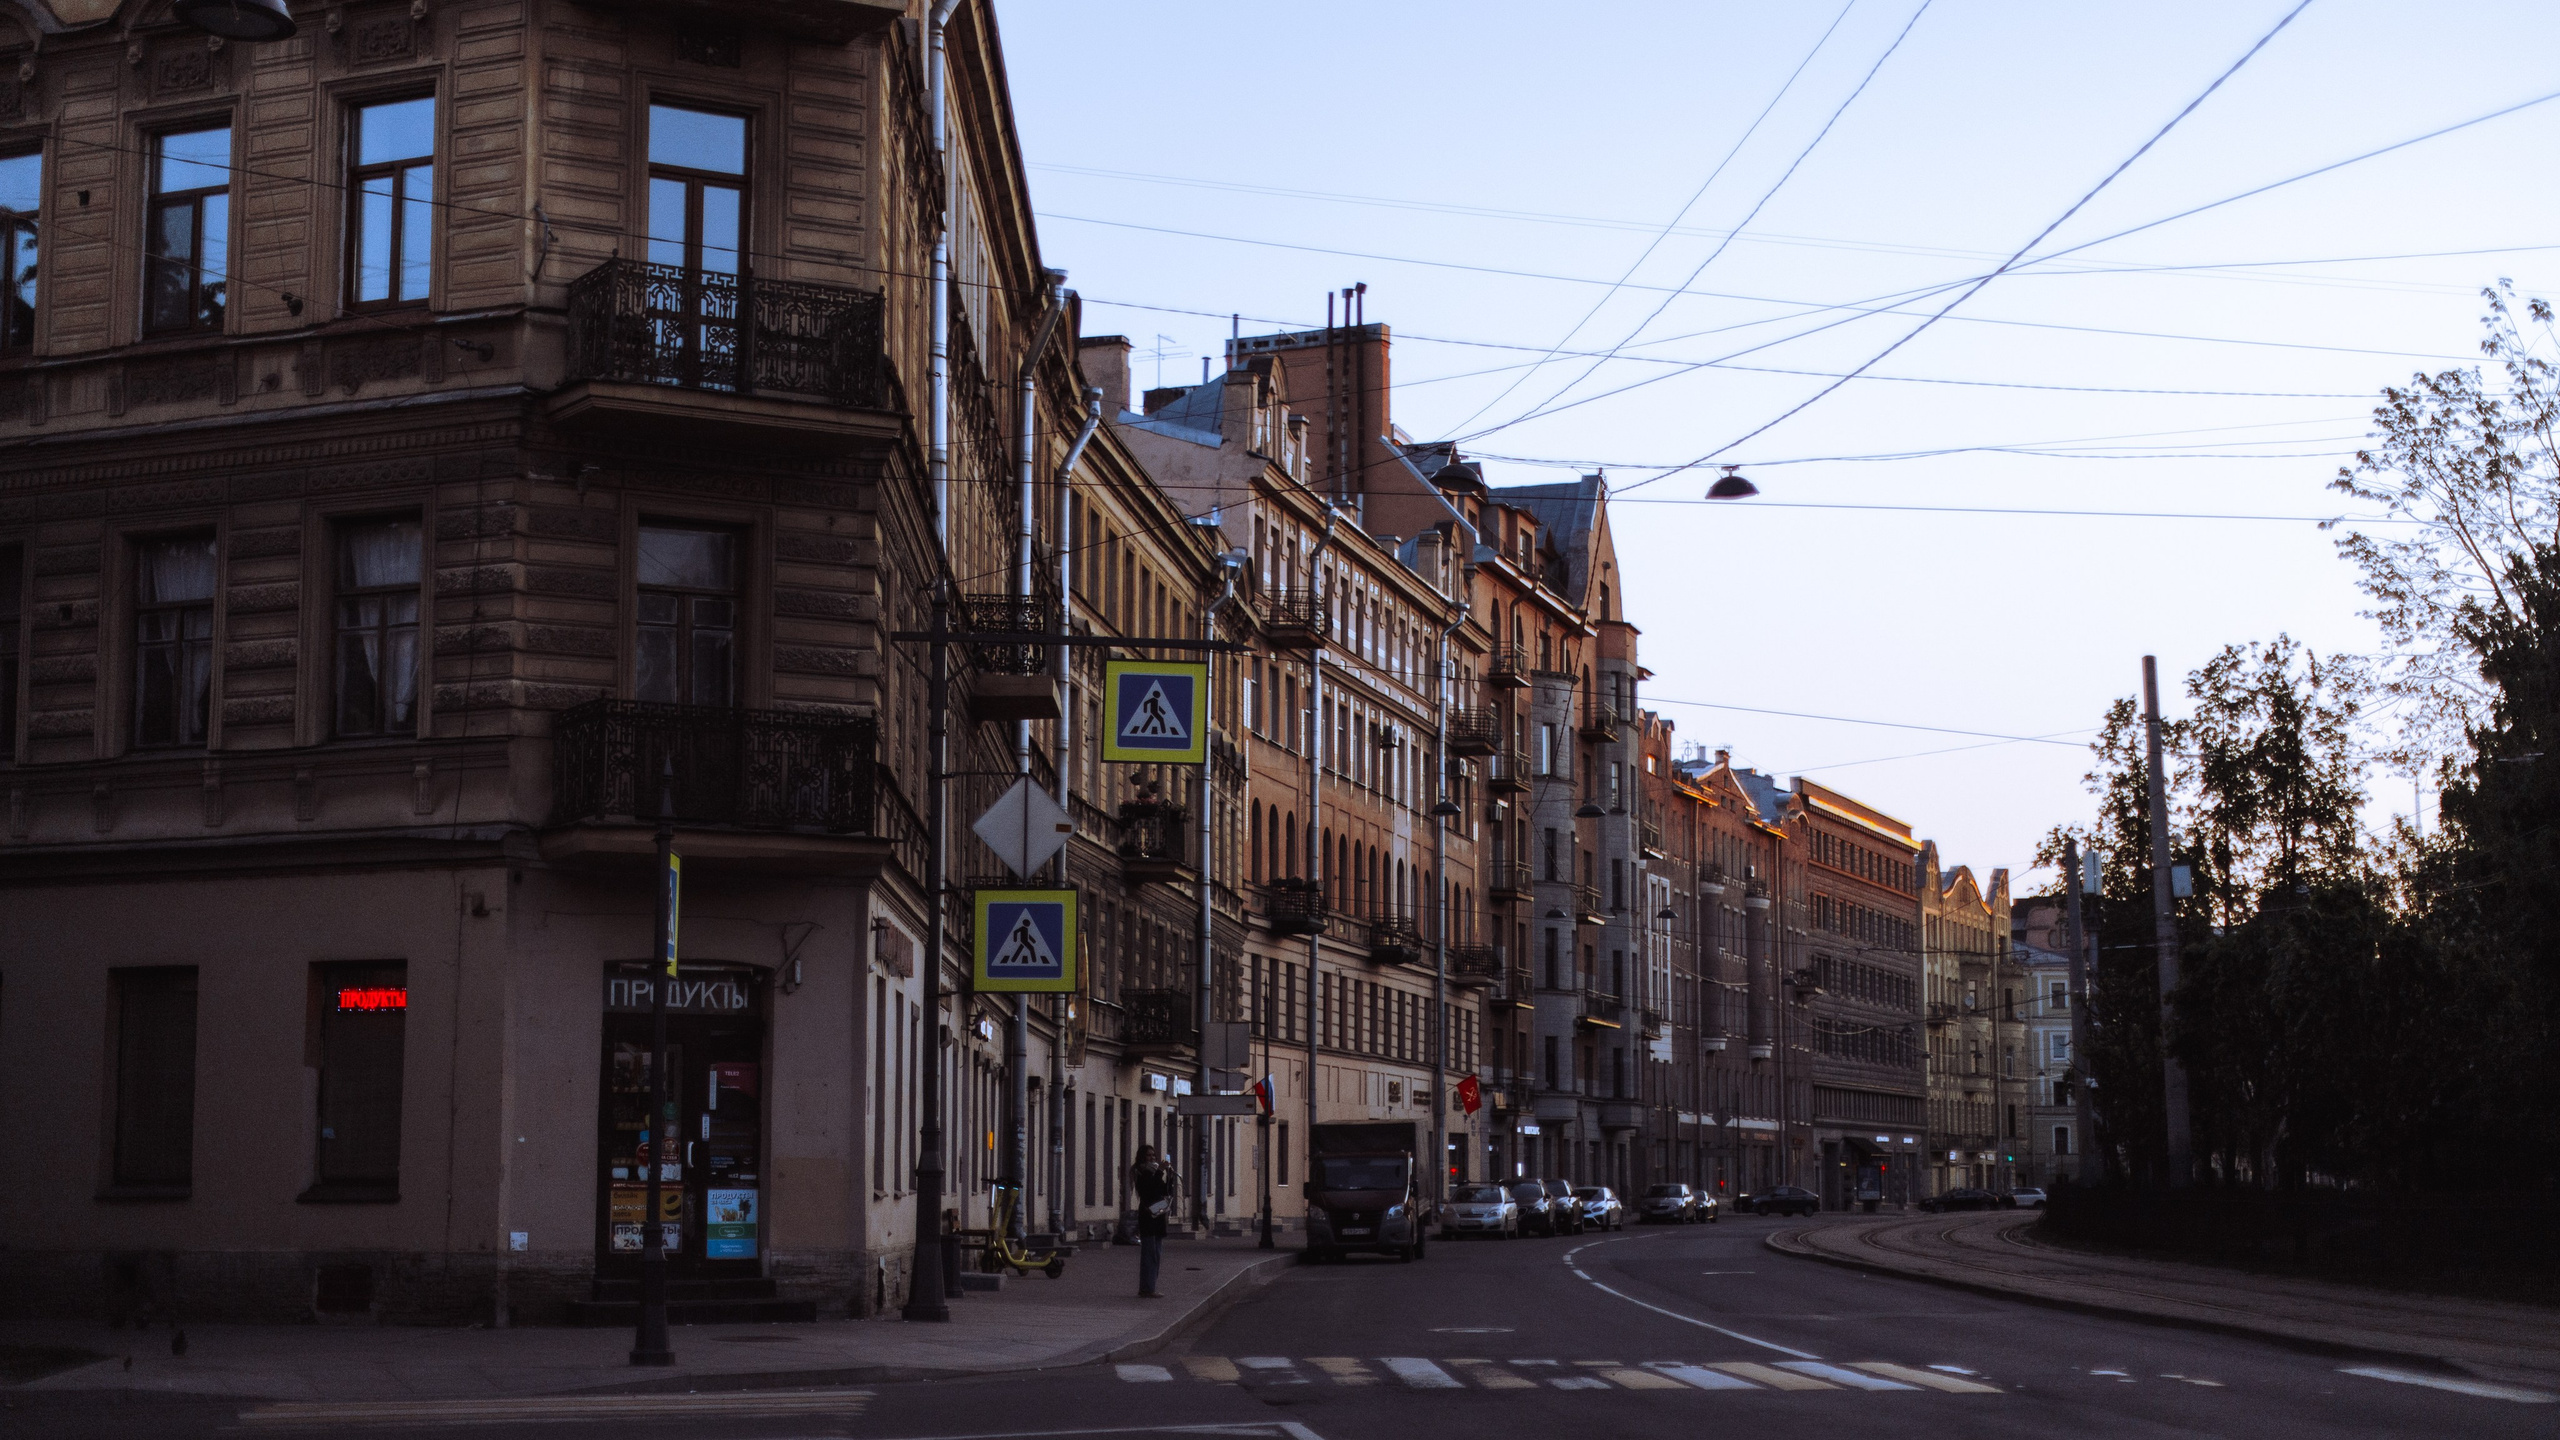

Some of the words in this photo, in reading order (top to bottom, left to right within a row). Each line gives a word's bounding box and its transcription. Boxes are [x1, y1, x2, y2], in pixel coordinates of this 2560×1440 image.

[340, 990, 407, 1009] ПРОДУКТЫ
[610, 979, 748, 1009] ПРДУКТЫ
[712, 1192, 754, 1200] ПРОДУКТЫ
[623, 1239, 636, 1247] 24
